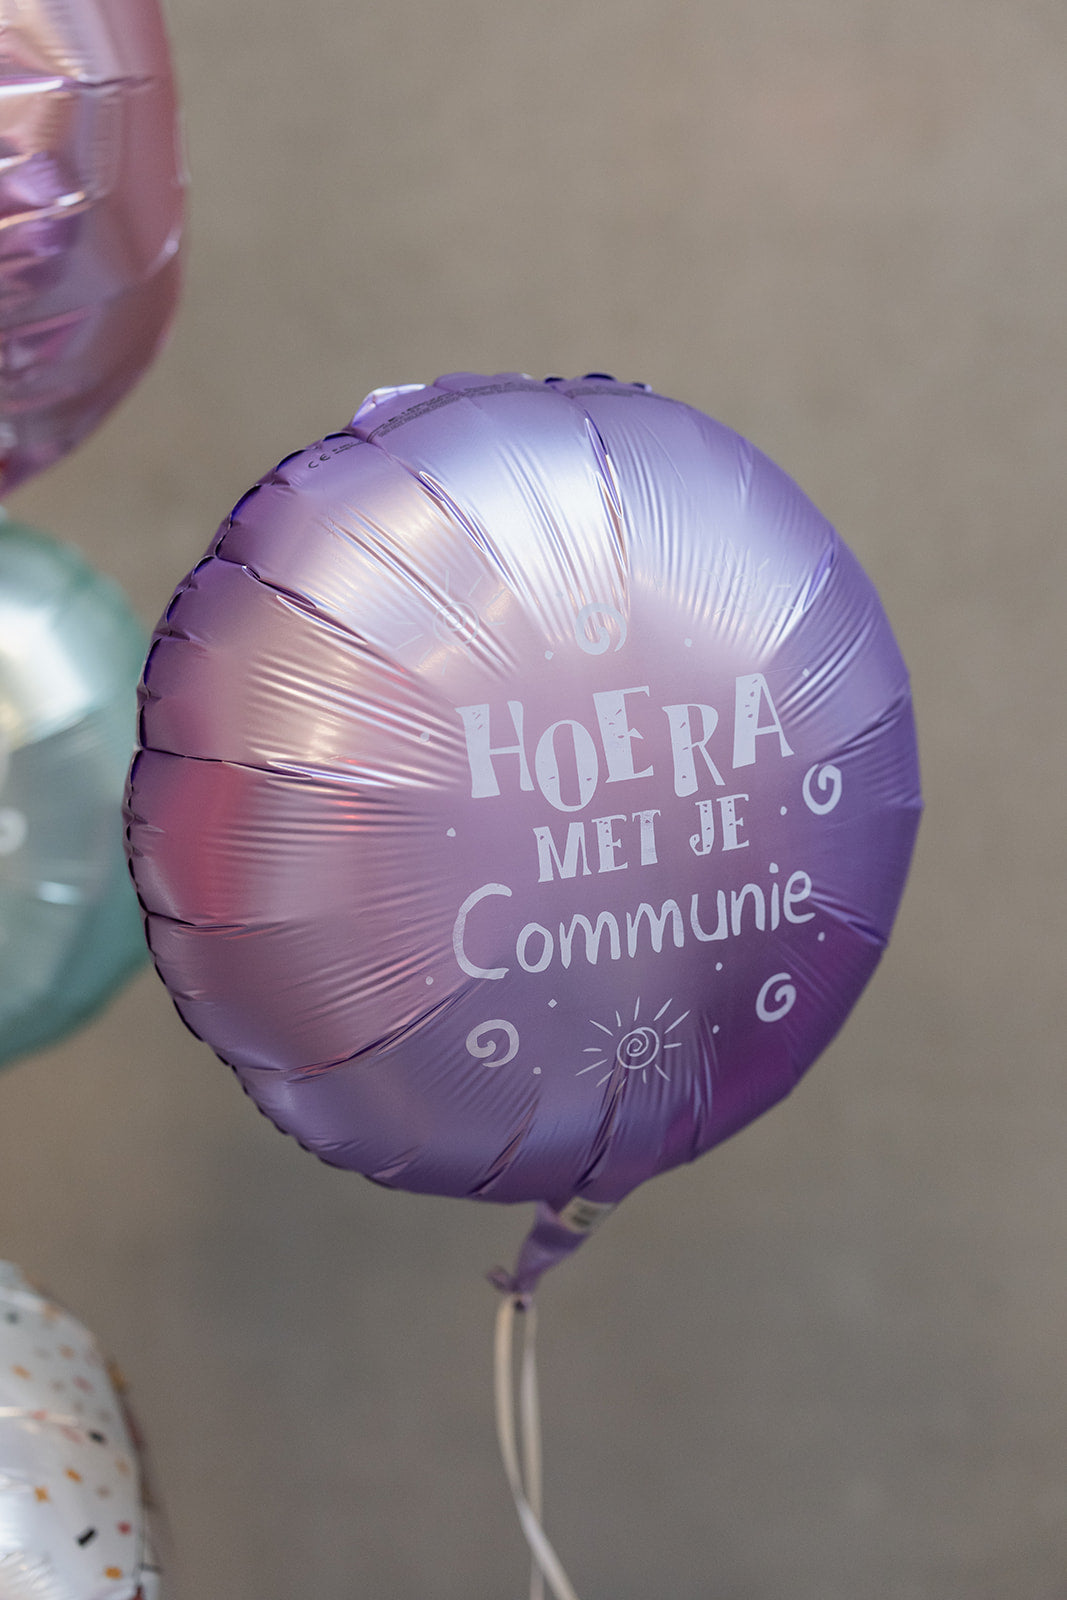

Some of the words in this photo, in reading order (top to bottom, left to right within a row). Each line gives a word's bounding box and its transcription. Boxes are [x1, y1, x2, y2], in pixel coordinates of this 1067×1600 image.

[454, 672, 795, 813] HOERA
[532, 808, 662, 883] MET
[688, 793, 750, 857] JE
[452, 862, 816, 981] Communie
